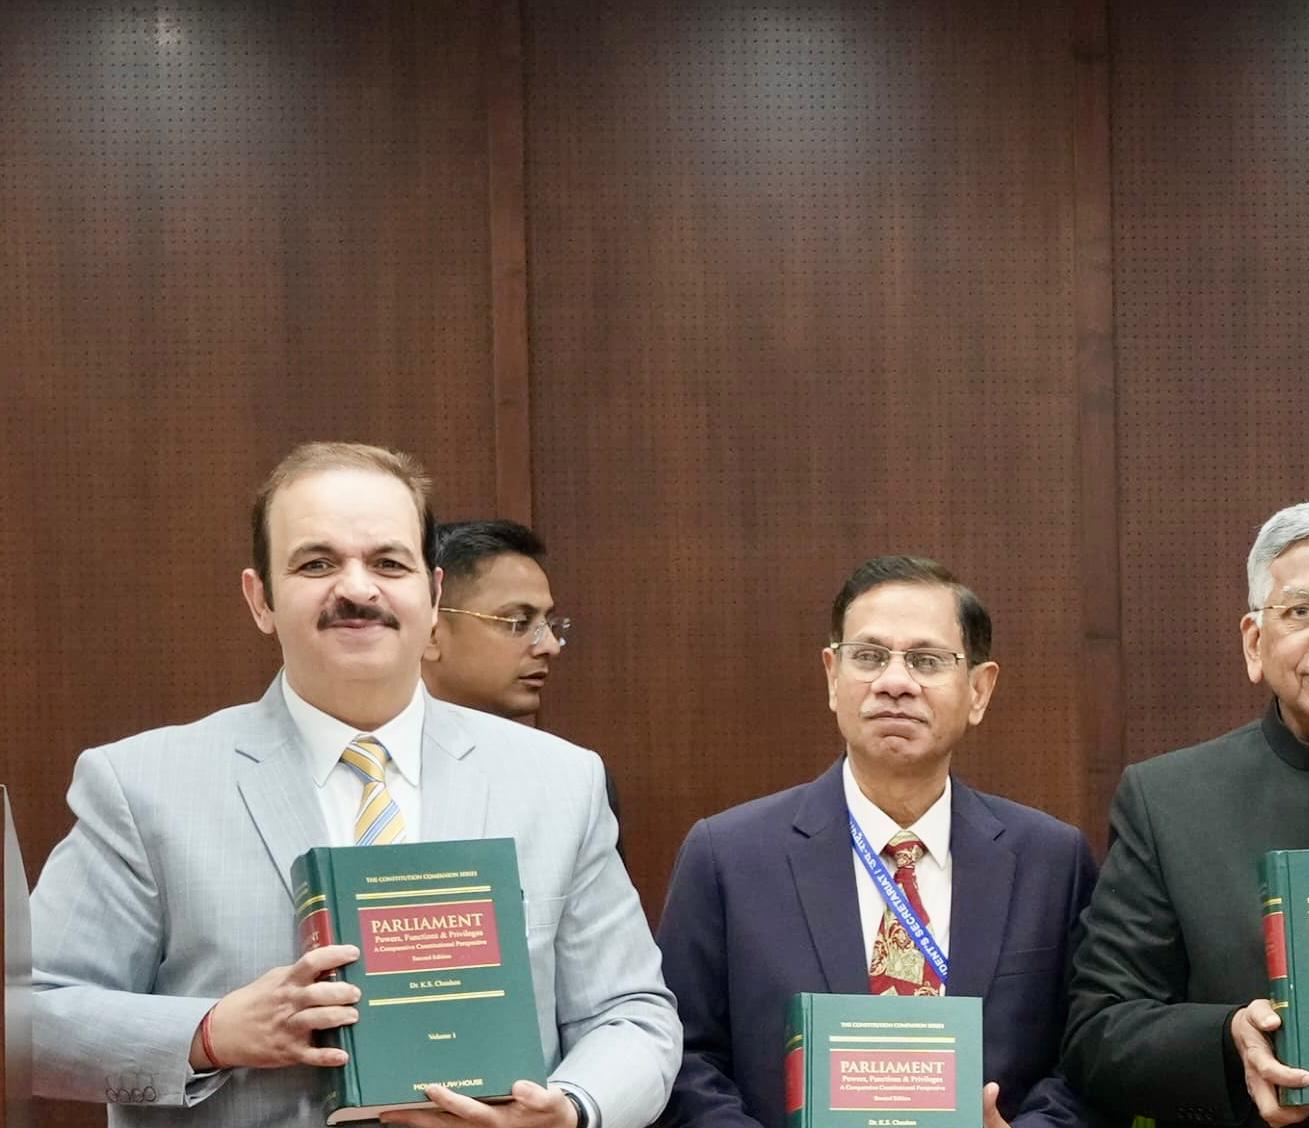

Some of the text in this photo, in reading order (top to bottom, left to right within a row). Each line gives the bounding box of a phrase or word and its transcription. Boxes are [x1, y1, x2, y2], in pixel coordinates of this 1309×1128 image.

[876, 872, 925, 938] SECRETARIAT
[372, 913, 484, 933] PARLIAMENT
[375, 934, 403, 943] Powers,
[404, 932, 438, 941] Functions
[449, 929, 483, 940] Privileges
[428, 1033, 452, 1041] Volume
[841, 1061, 945, 1074] PARLIAMENT
[458, 1079, 483, 1088] HOUSE
[911, 1076, 943, 1084] Privileges
